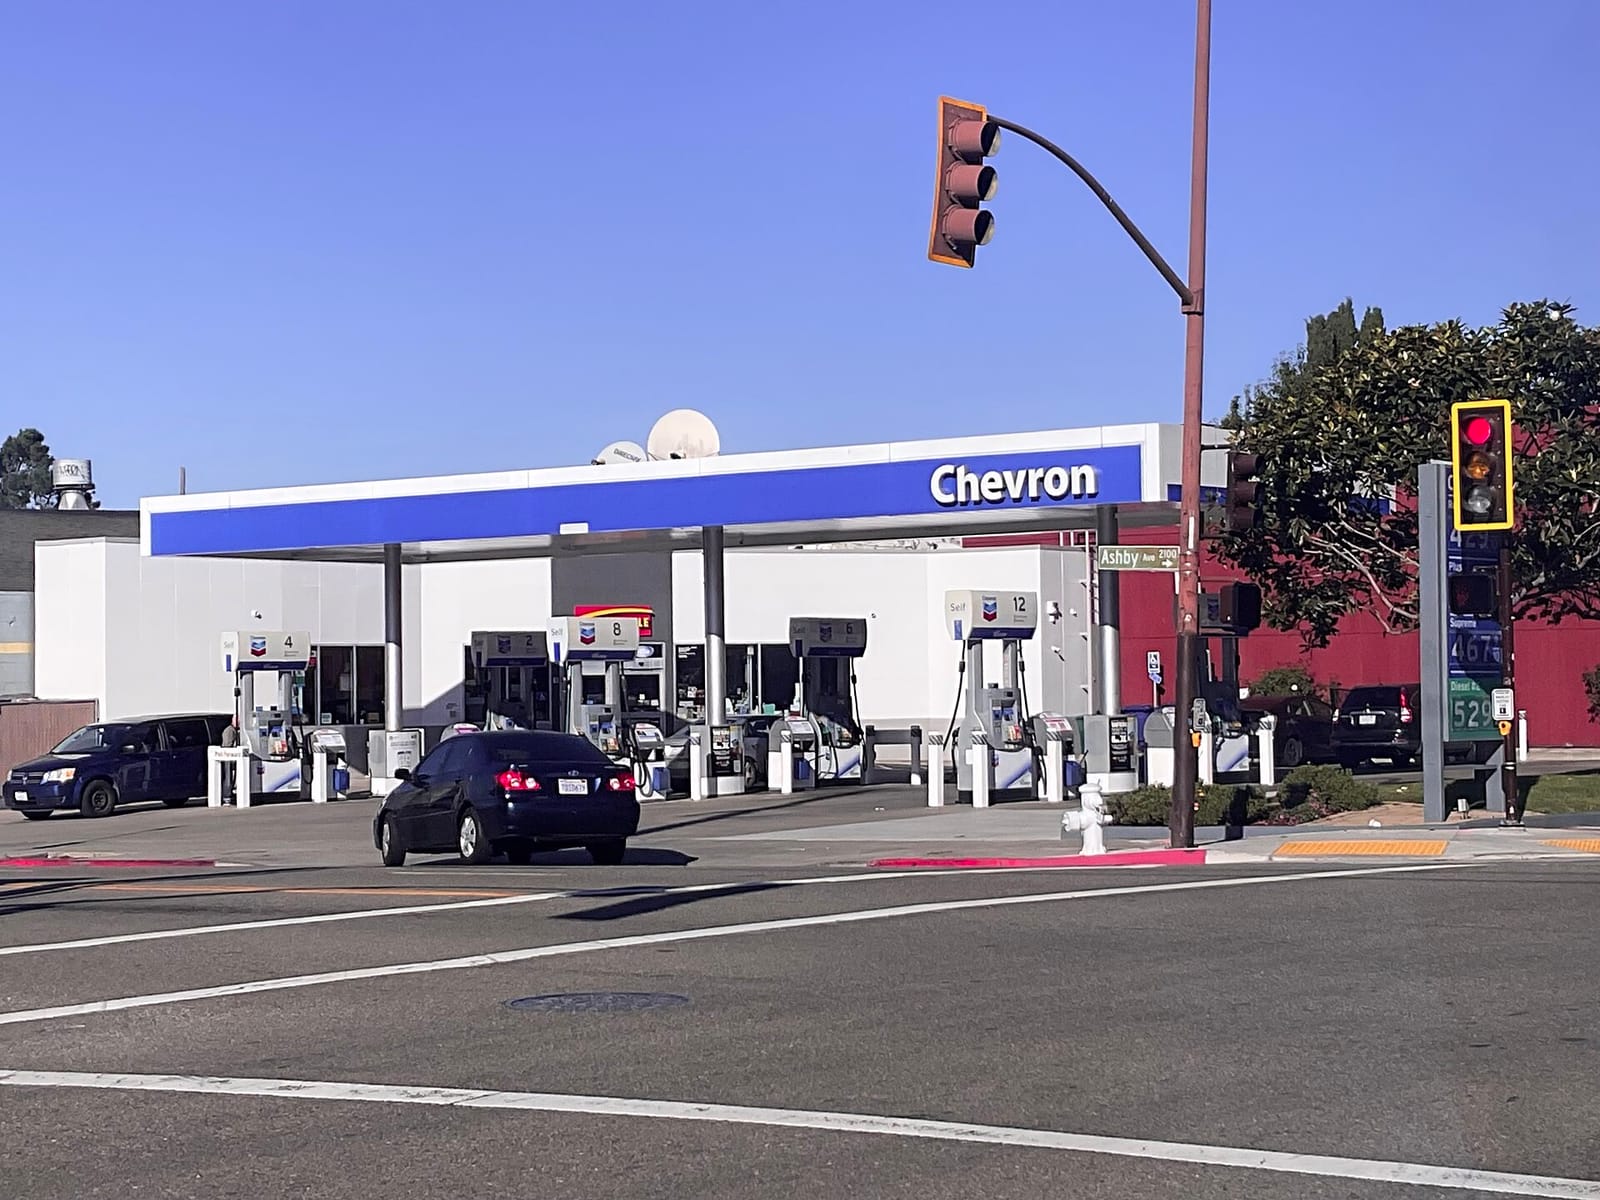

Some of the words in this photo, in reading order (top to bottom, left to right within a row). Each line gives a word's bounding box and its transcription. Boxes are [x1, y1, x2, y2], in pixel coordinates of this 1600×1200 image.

[930, 463, 1098, 505] Chevron
[1101, 549, 1139, 568] Ashby
[1142, 553, 1156, 562] Ave
[1158, 550, 1177, 559] 2100
[1448, 561, 1463, 573] Plus
[950, 602, 966, 612] Self
[1013, 596, 1026, 612] 12
[613, 622, 621, 636] 8
[846, 622, 853, 635] 6
[1449, 618, 1477, 629] Supreme
[284, 635, 293, 649] 4
[525, 634, 533, 647] 2
[1451, 634, 1491, 662] 467
[1450, 681, 1471, 691] Diesel
[1454, 700, 1492, 728] 529
